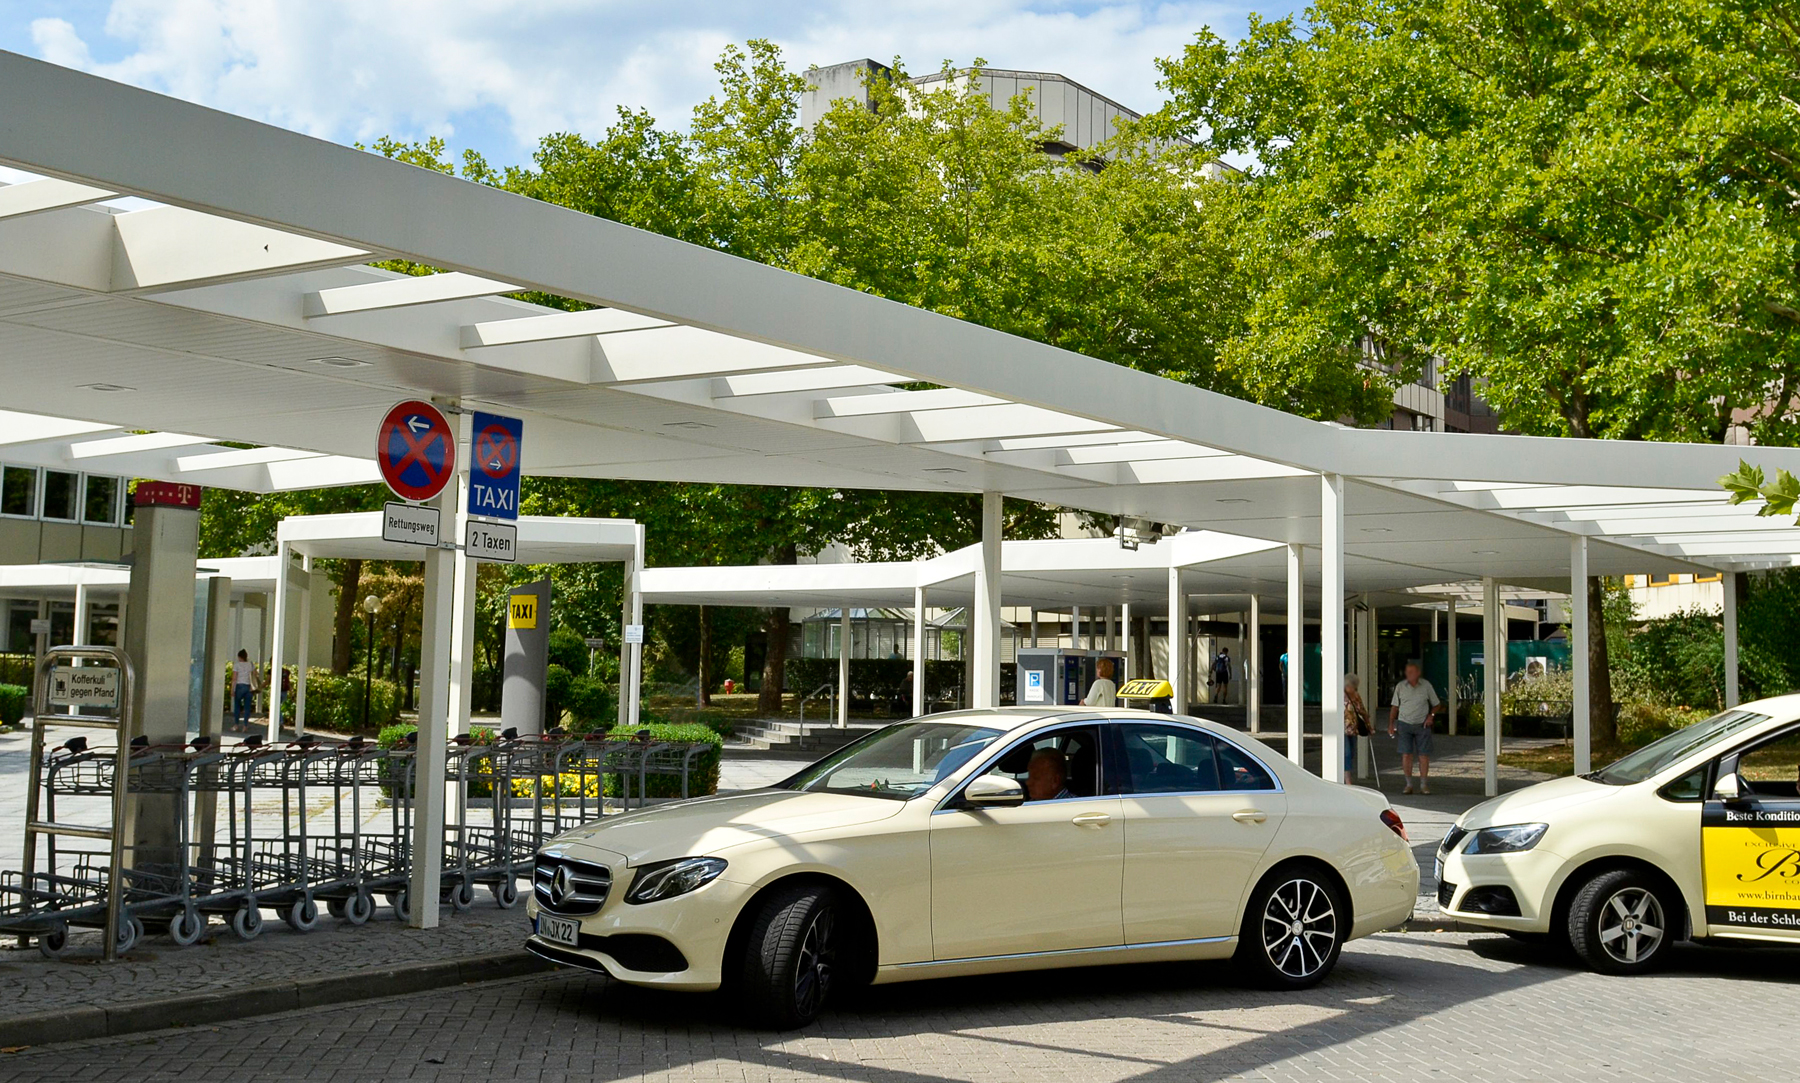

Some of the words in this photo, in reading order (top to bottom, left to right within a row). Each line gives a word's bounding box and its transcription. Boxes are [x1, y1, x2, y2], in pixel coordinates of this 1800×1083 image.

[474, 484, 514, 511] TAXI
[388, 516, 435, 535] Rettungsweg
[472, 531, 478, 548] 2
[482, 532, 511, 551] Taxen
[512, 604, 532, 619] TAXI
[71, 674, 105, 685] Kofferkuli
[70, 688, 92, 698] gegen
[94, 687, 114, 698] Pfand
[1123, 682, 1158, 695] TAXI
[1726, 811, 1753, 821] Beste
[1756, 811, 1800, 821] Konditio
[1728, 911, 1746, 922] Bei
[1750, 911, 1769, 924] der
[561, 922, 573, 942] 22
